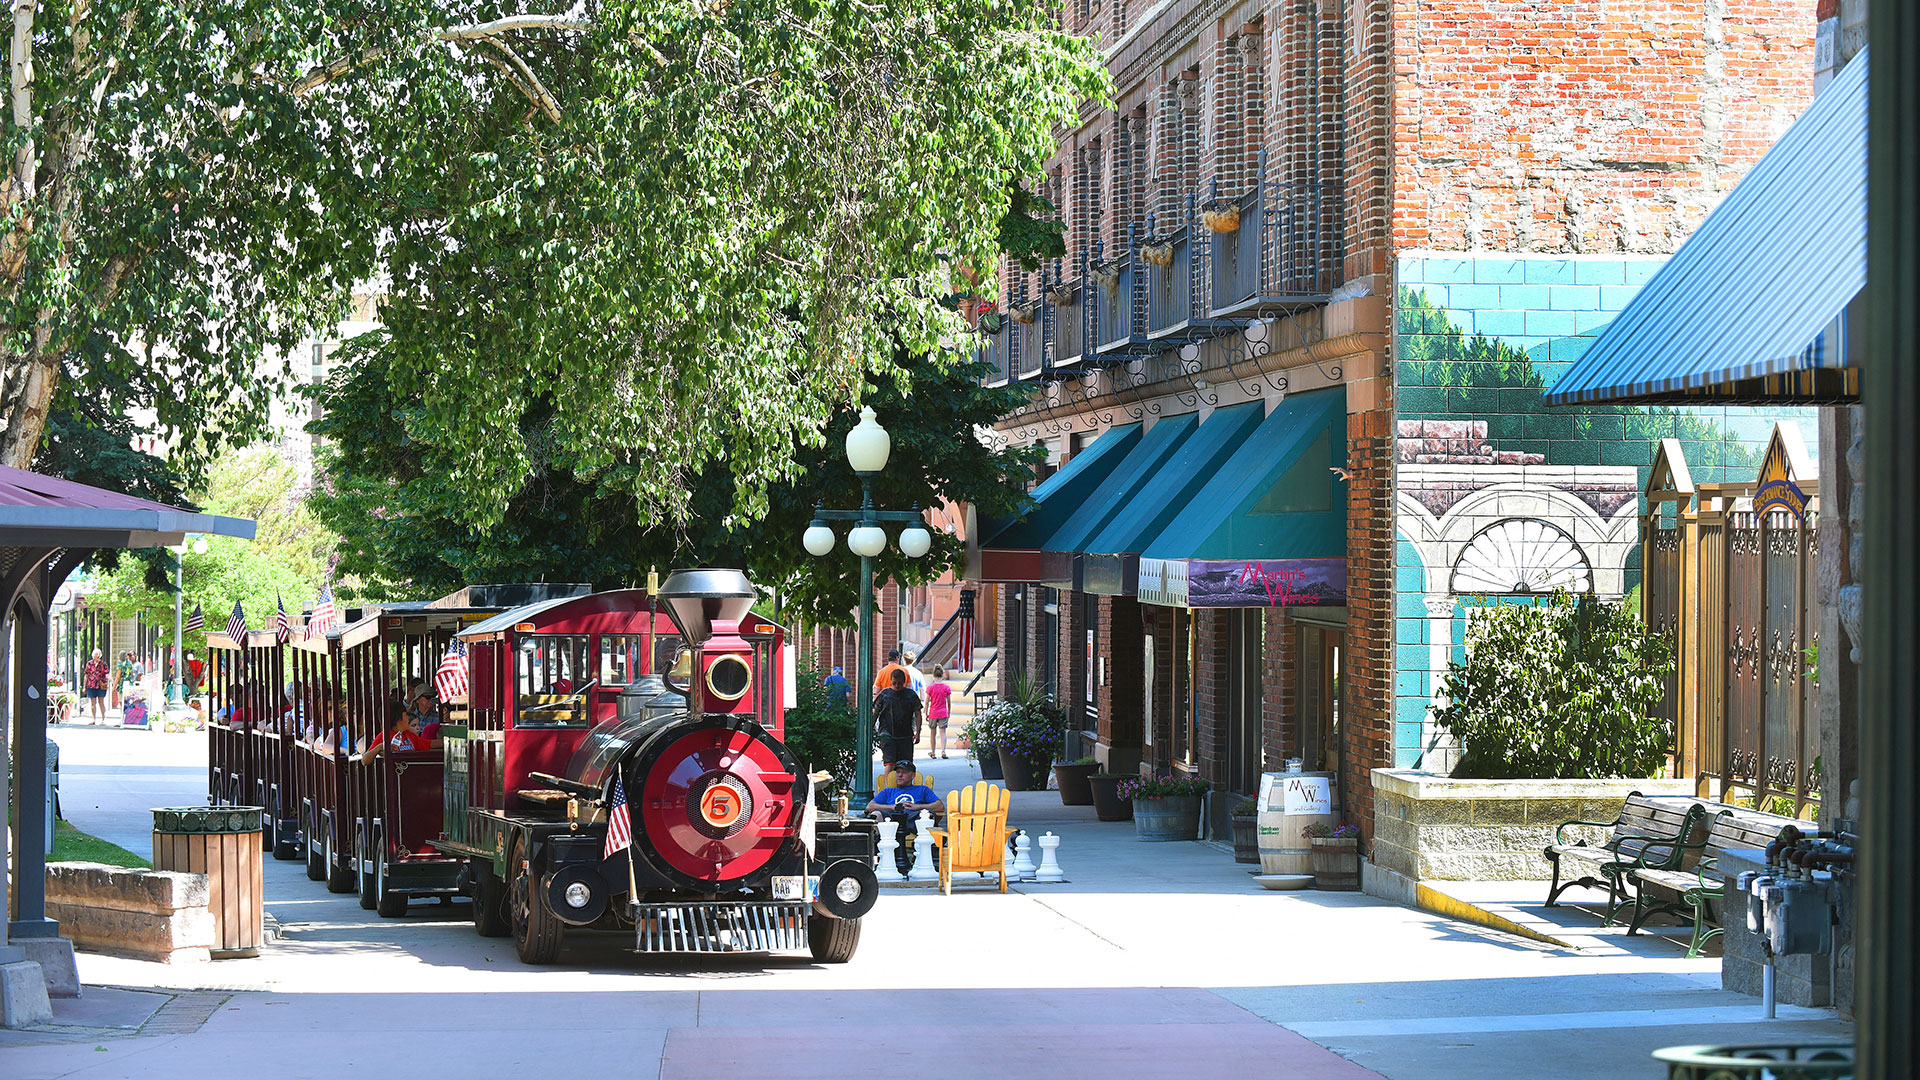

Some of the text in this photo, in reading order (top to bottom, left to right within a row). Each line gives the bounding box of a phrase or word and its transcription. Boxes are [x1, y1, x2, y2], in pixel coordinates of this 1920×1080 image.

[1239, 561, 1306, 584] Martin's
[1264, 580, 1320, 607] Wines
[1289, 780, 1320, 792] Martin's
[1302, 789, 1328, 803] Wines
[711, 795, 731, 817] 5
